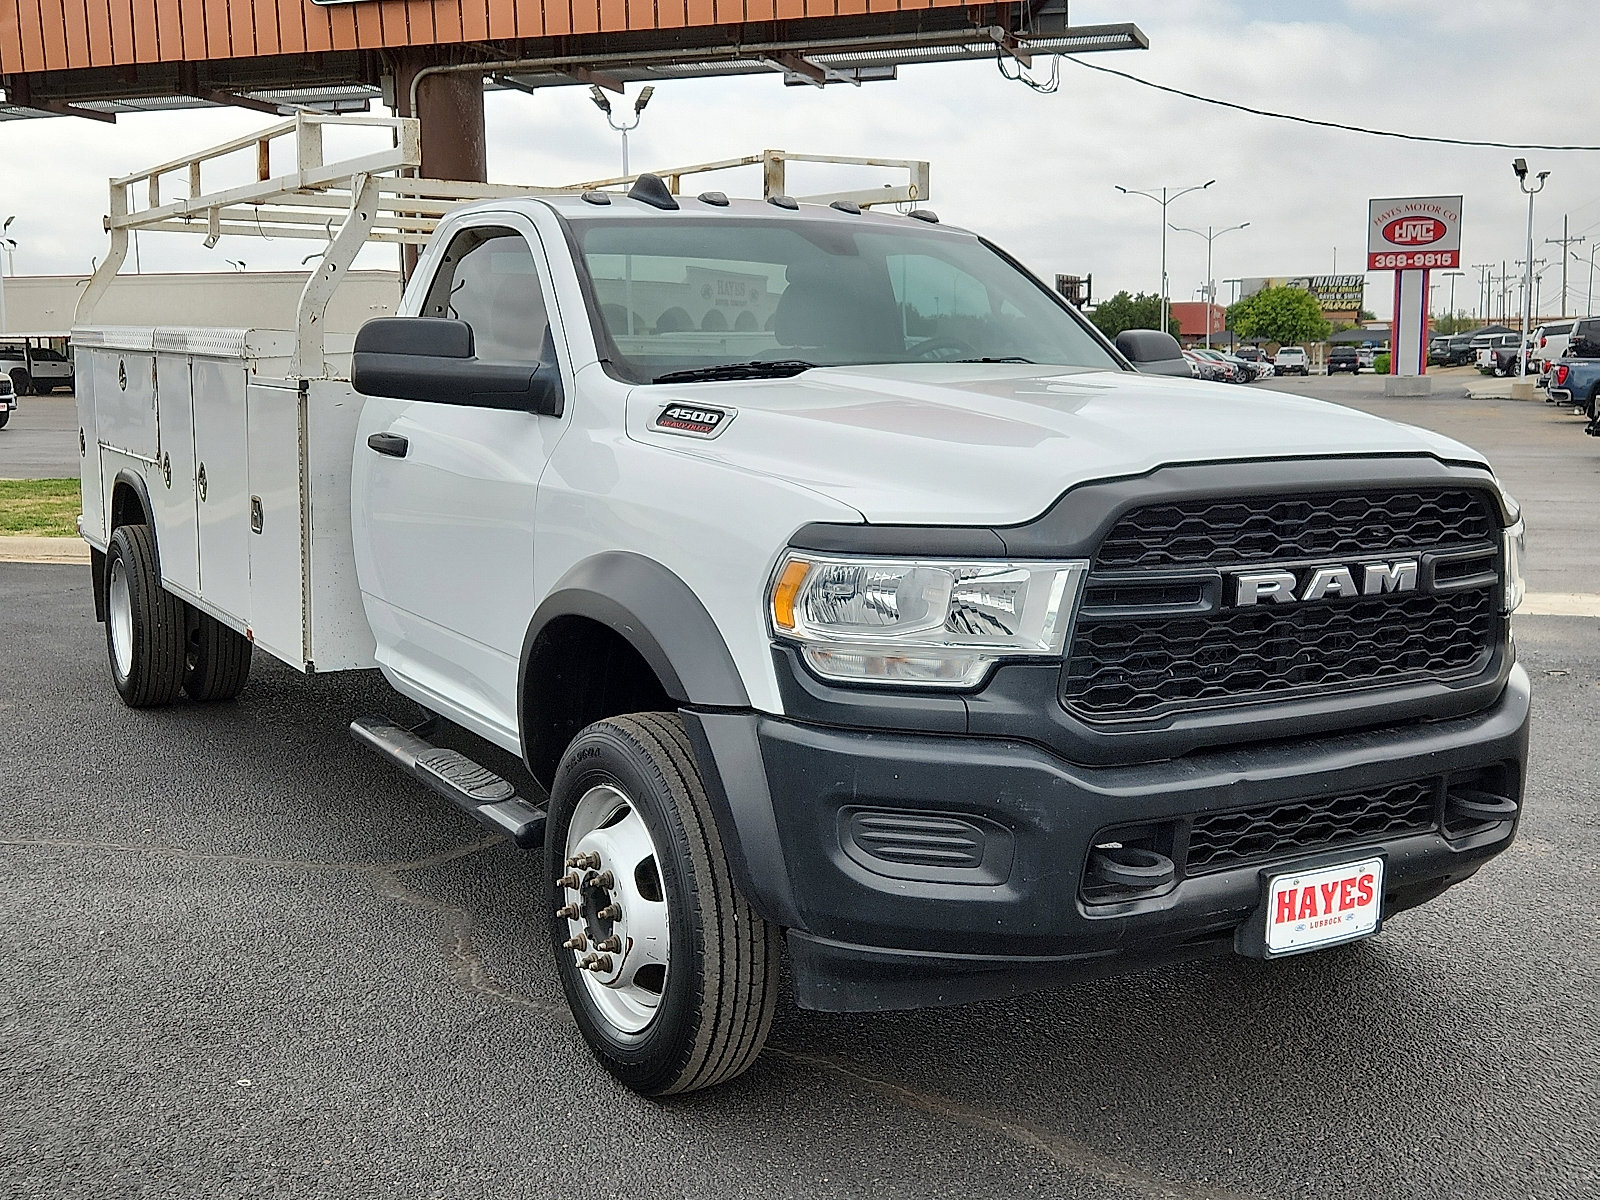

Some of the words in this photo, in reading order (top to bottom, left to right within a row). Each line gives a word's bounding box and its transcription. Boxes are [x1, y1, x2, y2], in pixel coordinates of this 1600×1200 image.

[1373, 206, 1402, 226] HAYES
[1404, 202, 1441, 215] MOTOR
[1394, 220, 1435, 242] HMC
[1374, 253, 1452, 268] 368-9815
[1312, 276, 1363, 288] INJURED?
[666, 408, 719, 424] 4500
[1234, 560, 1418, 608] RAM
[1275, 873, 1374, 925] HAYES
[1309, 916, 1342, 929] LUBBOCK
